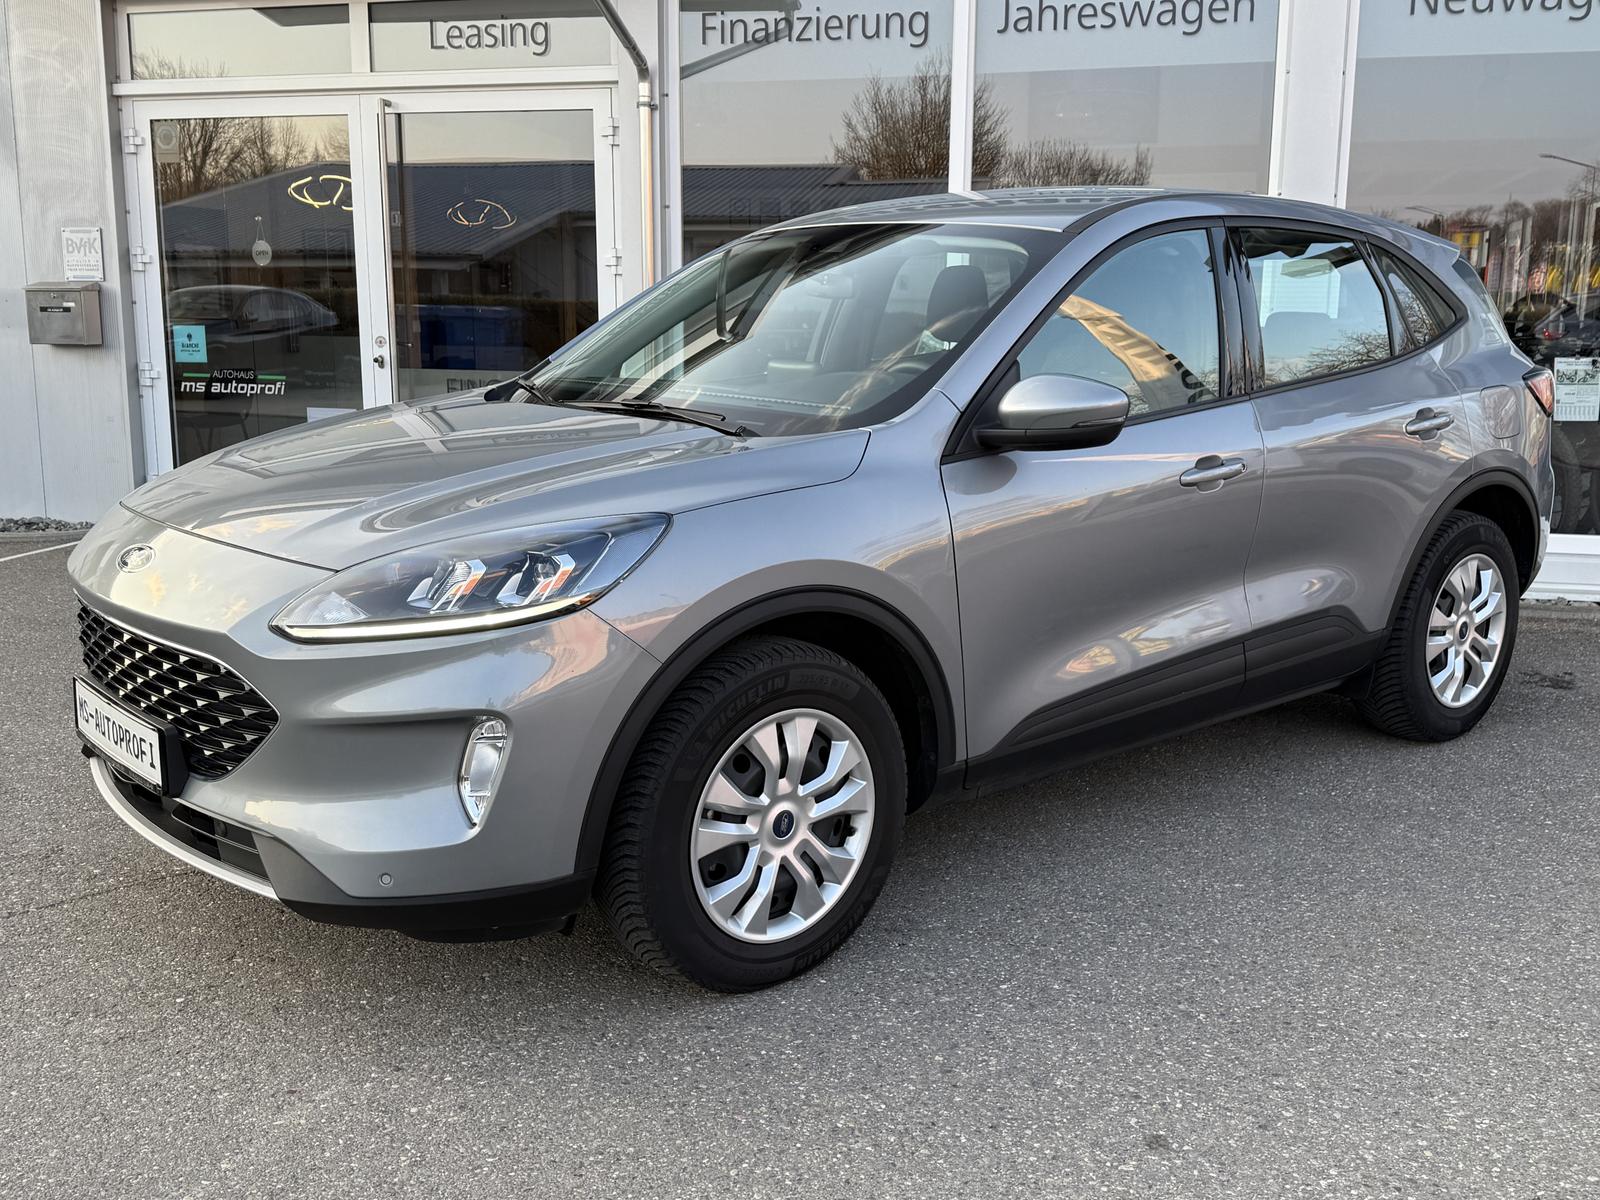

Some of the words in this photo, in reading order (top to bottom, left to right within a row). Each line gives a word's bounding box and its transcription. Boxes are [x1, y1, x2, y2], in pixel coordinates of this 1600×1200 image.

[429, 14, 550, 56] Leasing
[701, 6, 929, 48] Finanzierung
[997, 0, 1255, 36] Jahreswagen
[180, 381, 206, 393] ms
[210, 380, 286, 397] autoprofi
[212, 369, 255, 379] AUTOHAUS
[705, 671, 786, 741] MICHELIN
